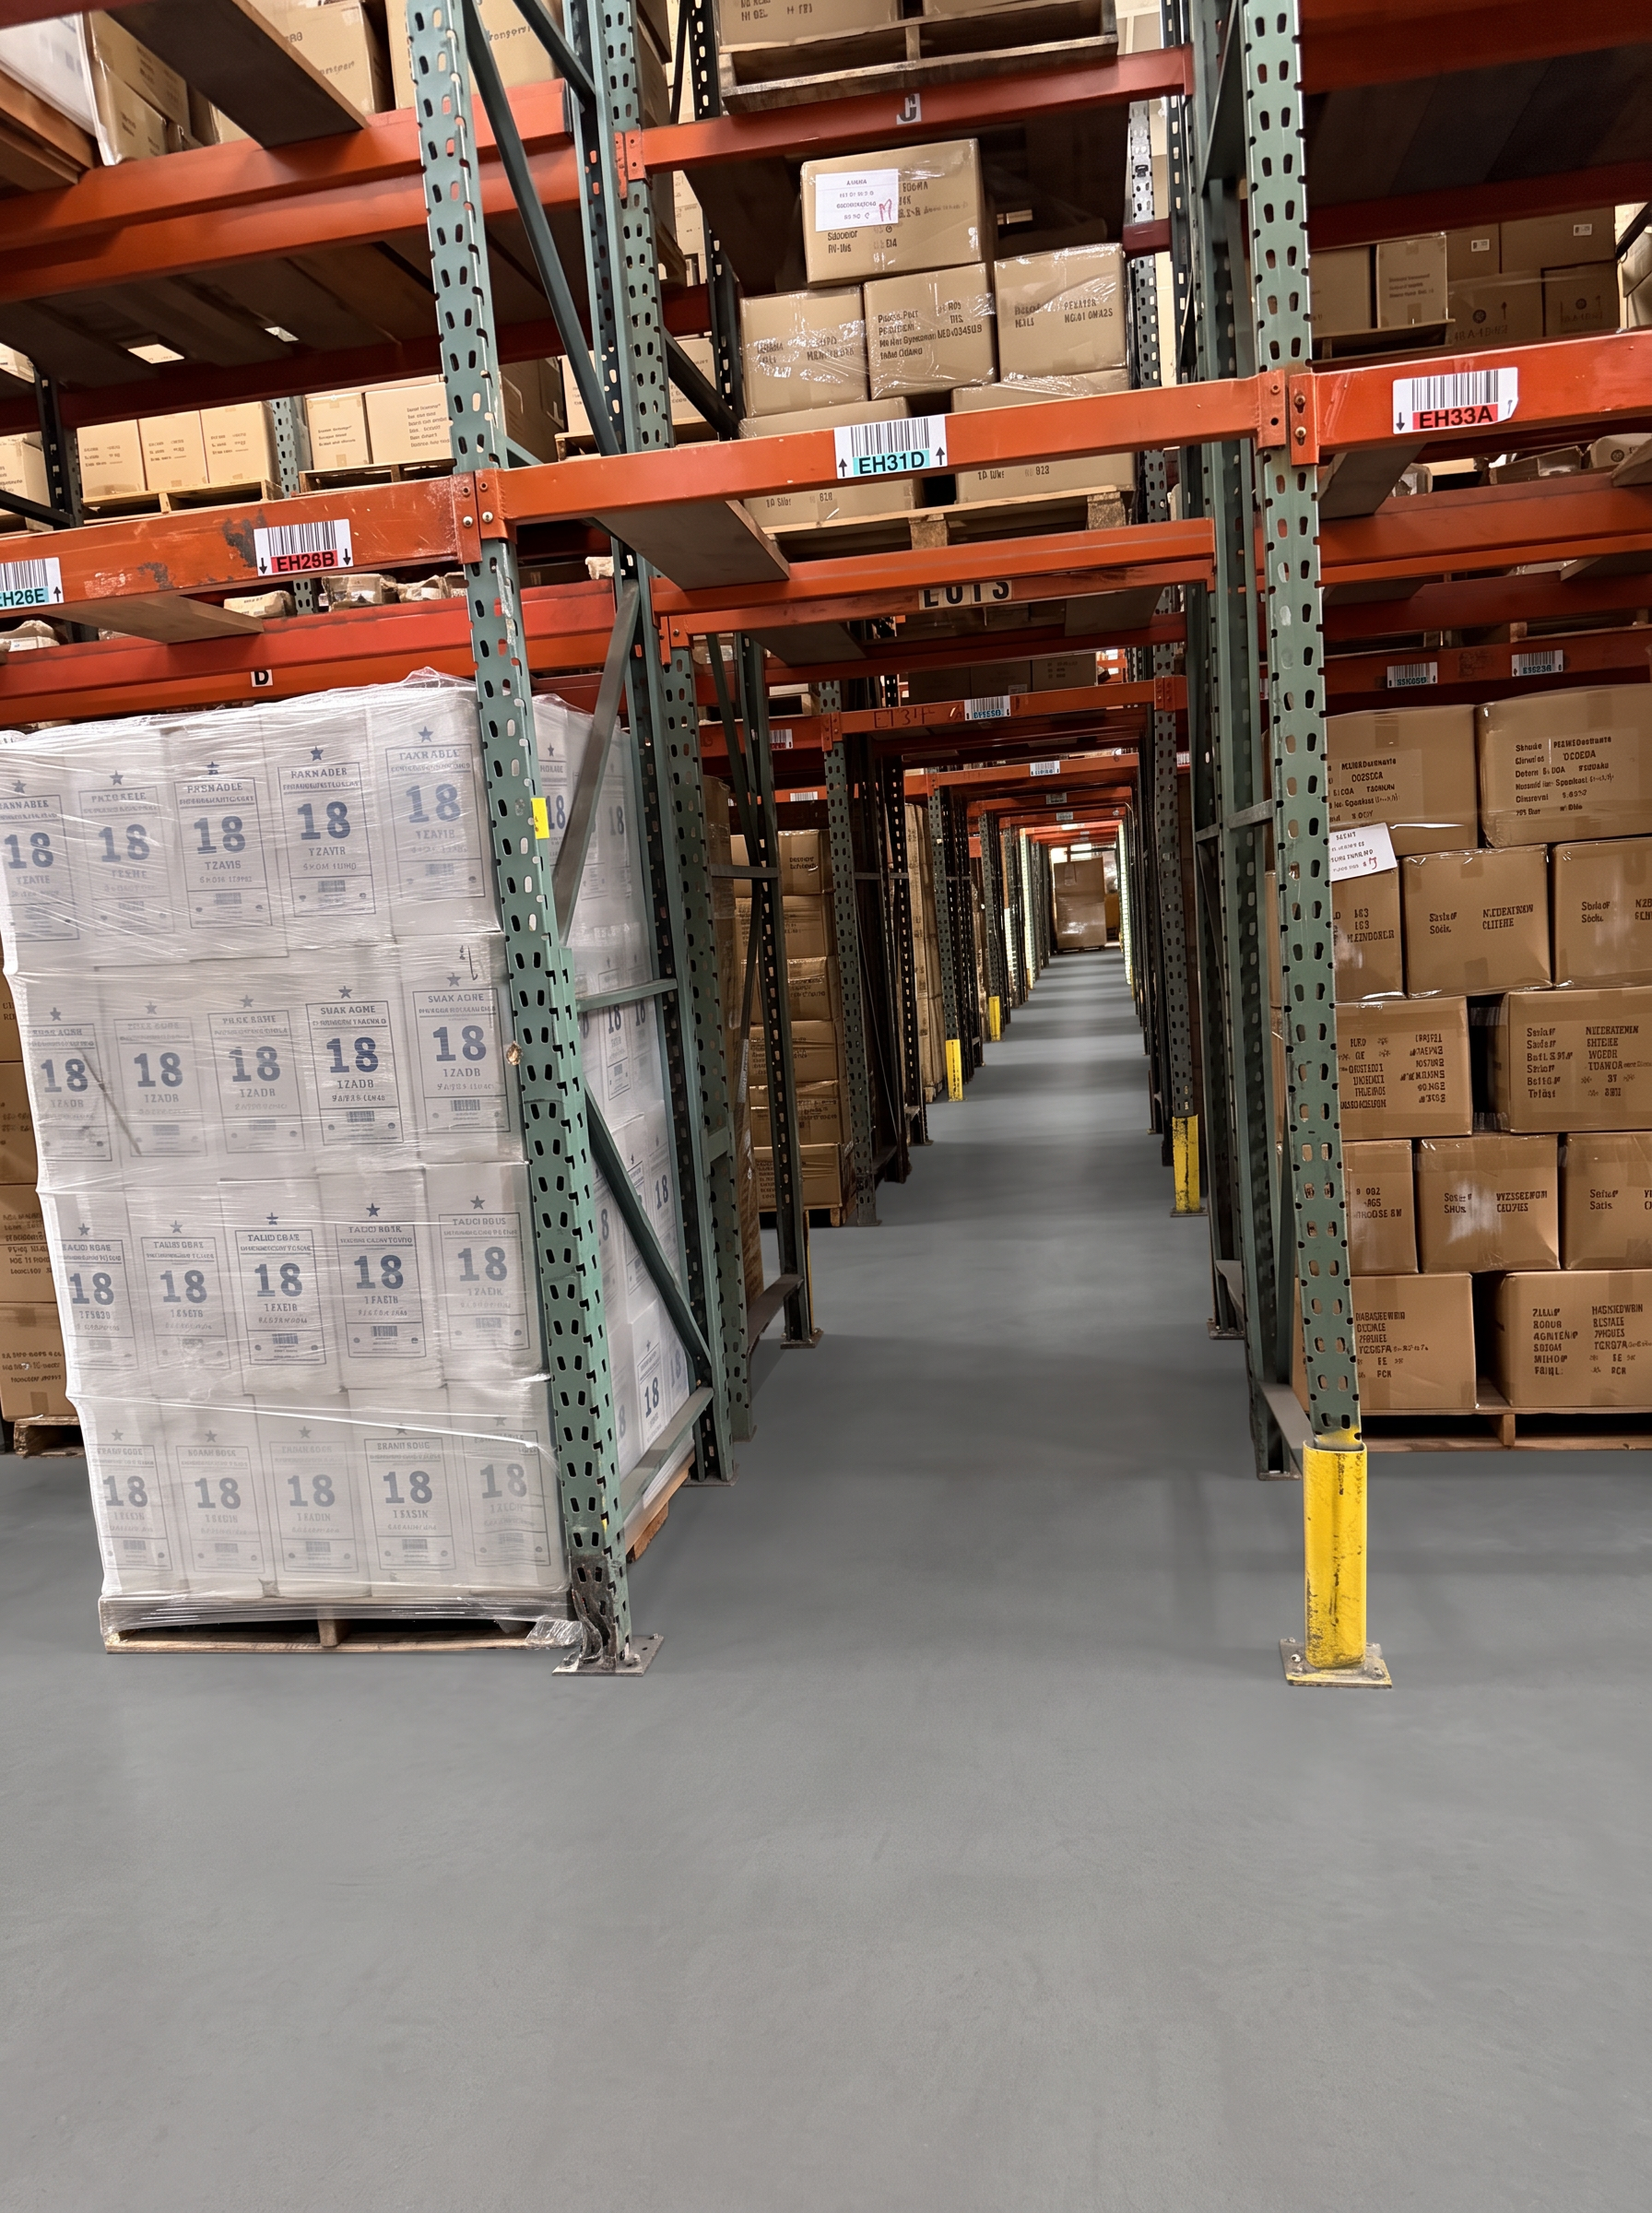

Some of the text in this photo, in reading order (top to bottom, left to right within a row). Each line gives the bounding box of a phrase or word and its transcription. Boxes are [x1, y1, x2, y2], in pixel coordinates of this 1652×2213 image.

[1419, 405, 1493, 430] EH33A
[858, 450, 925, 475] EH31D
[254, 669, 270, 686] D
[297, 800, 351, 841] 18
[406, 783, 462, 823] 18
[608, 804, 625, 836] 18
[4, 832, 54, 869] 18
[98, 822, 150, 863] 18
[193, 815, 246, 855] 18
[325, 1036, 379, 1073] 18
[432, 1025, 487, 1061] 18
[41, 1059, 88, 1093] 18
[134, 1052, 183, 1087] 18
[228, 1046, 281, 1083] 18
[655, 1174, 669, 1211] 18
[254, 1262, 303, 1297] 18
[353, 1254, 404, 1289] 18
[457, 1246, 508, 1282] 18
[69, 1272, 115, 1306] 18
[159, 1270, 207, 1304] 18
[644, 1377, 660, 1418] 18
[102, 1475, 148, 1509] 18
[194, 1477, 242, 1509] 18
[287, 1473, 336, 1508] 18
[383, 1470, 433, 1504] 18
[479, 1462, 527, 1499] 18
